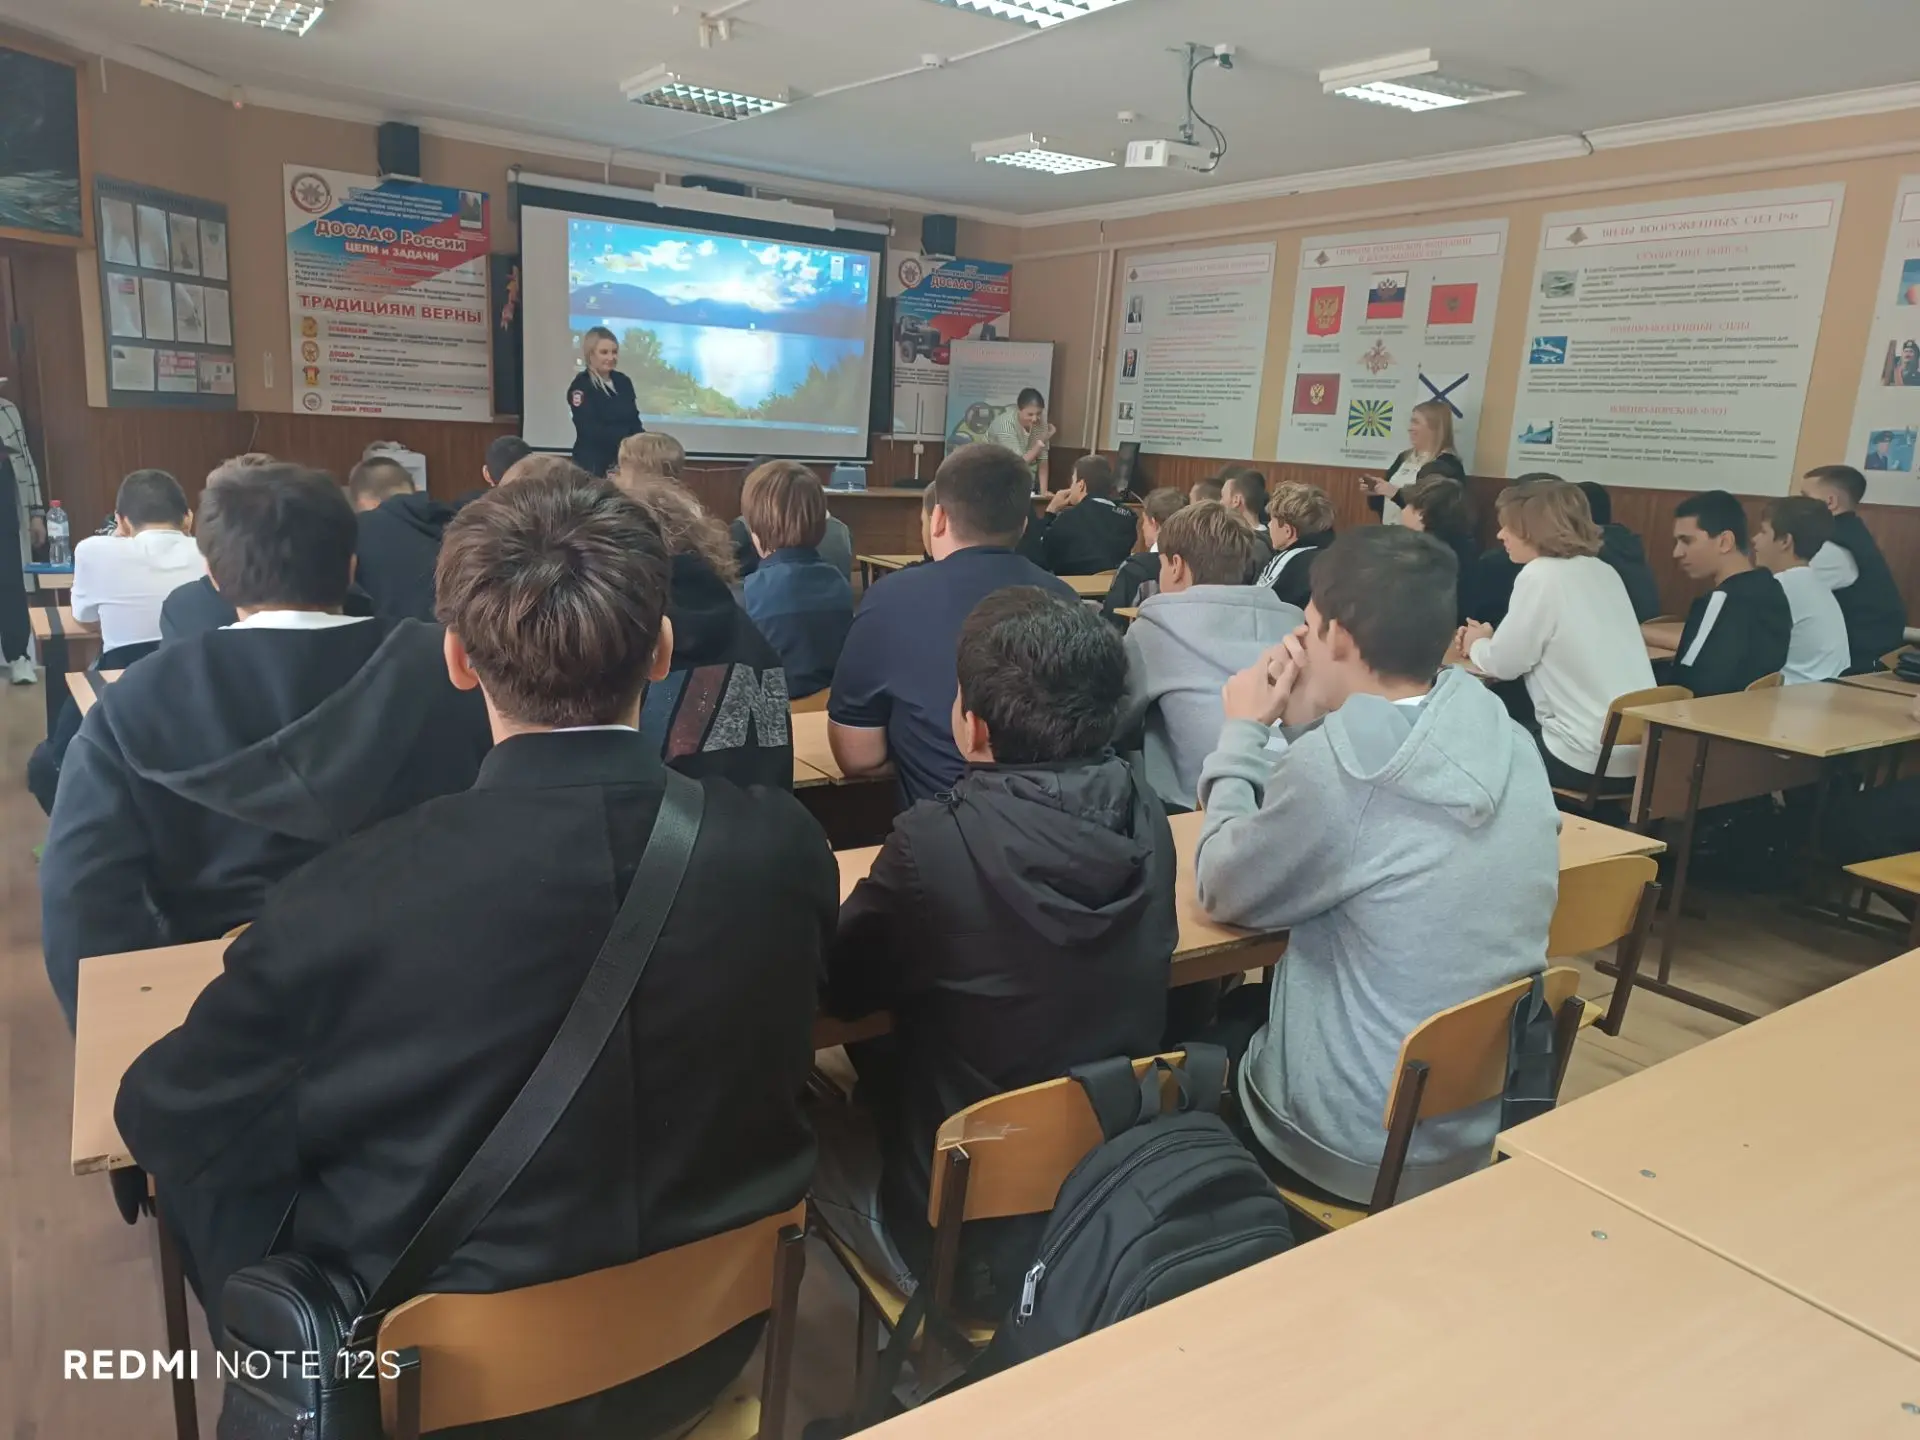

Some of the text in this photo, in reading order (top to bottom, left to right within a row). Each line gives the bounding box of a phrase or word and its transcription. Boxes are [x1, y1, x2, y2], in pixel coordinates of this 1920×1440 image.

[315, 219, 397, 243] ДОСААФ
[345, 241, 379, 255] ЦЕЛИ
[393, 245, 440, 262] ЗАДАЧИ
[299, 294, 482, 324] ТРАДИЦИЯМ ВЕРНЫ
